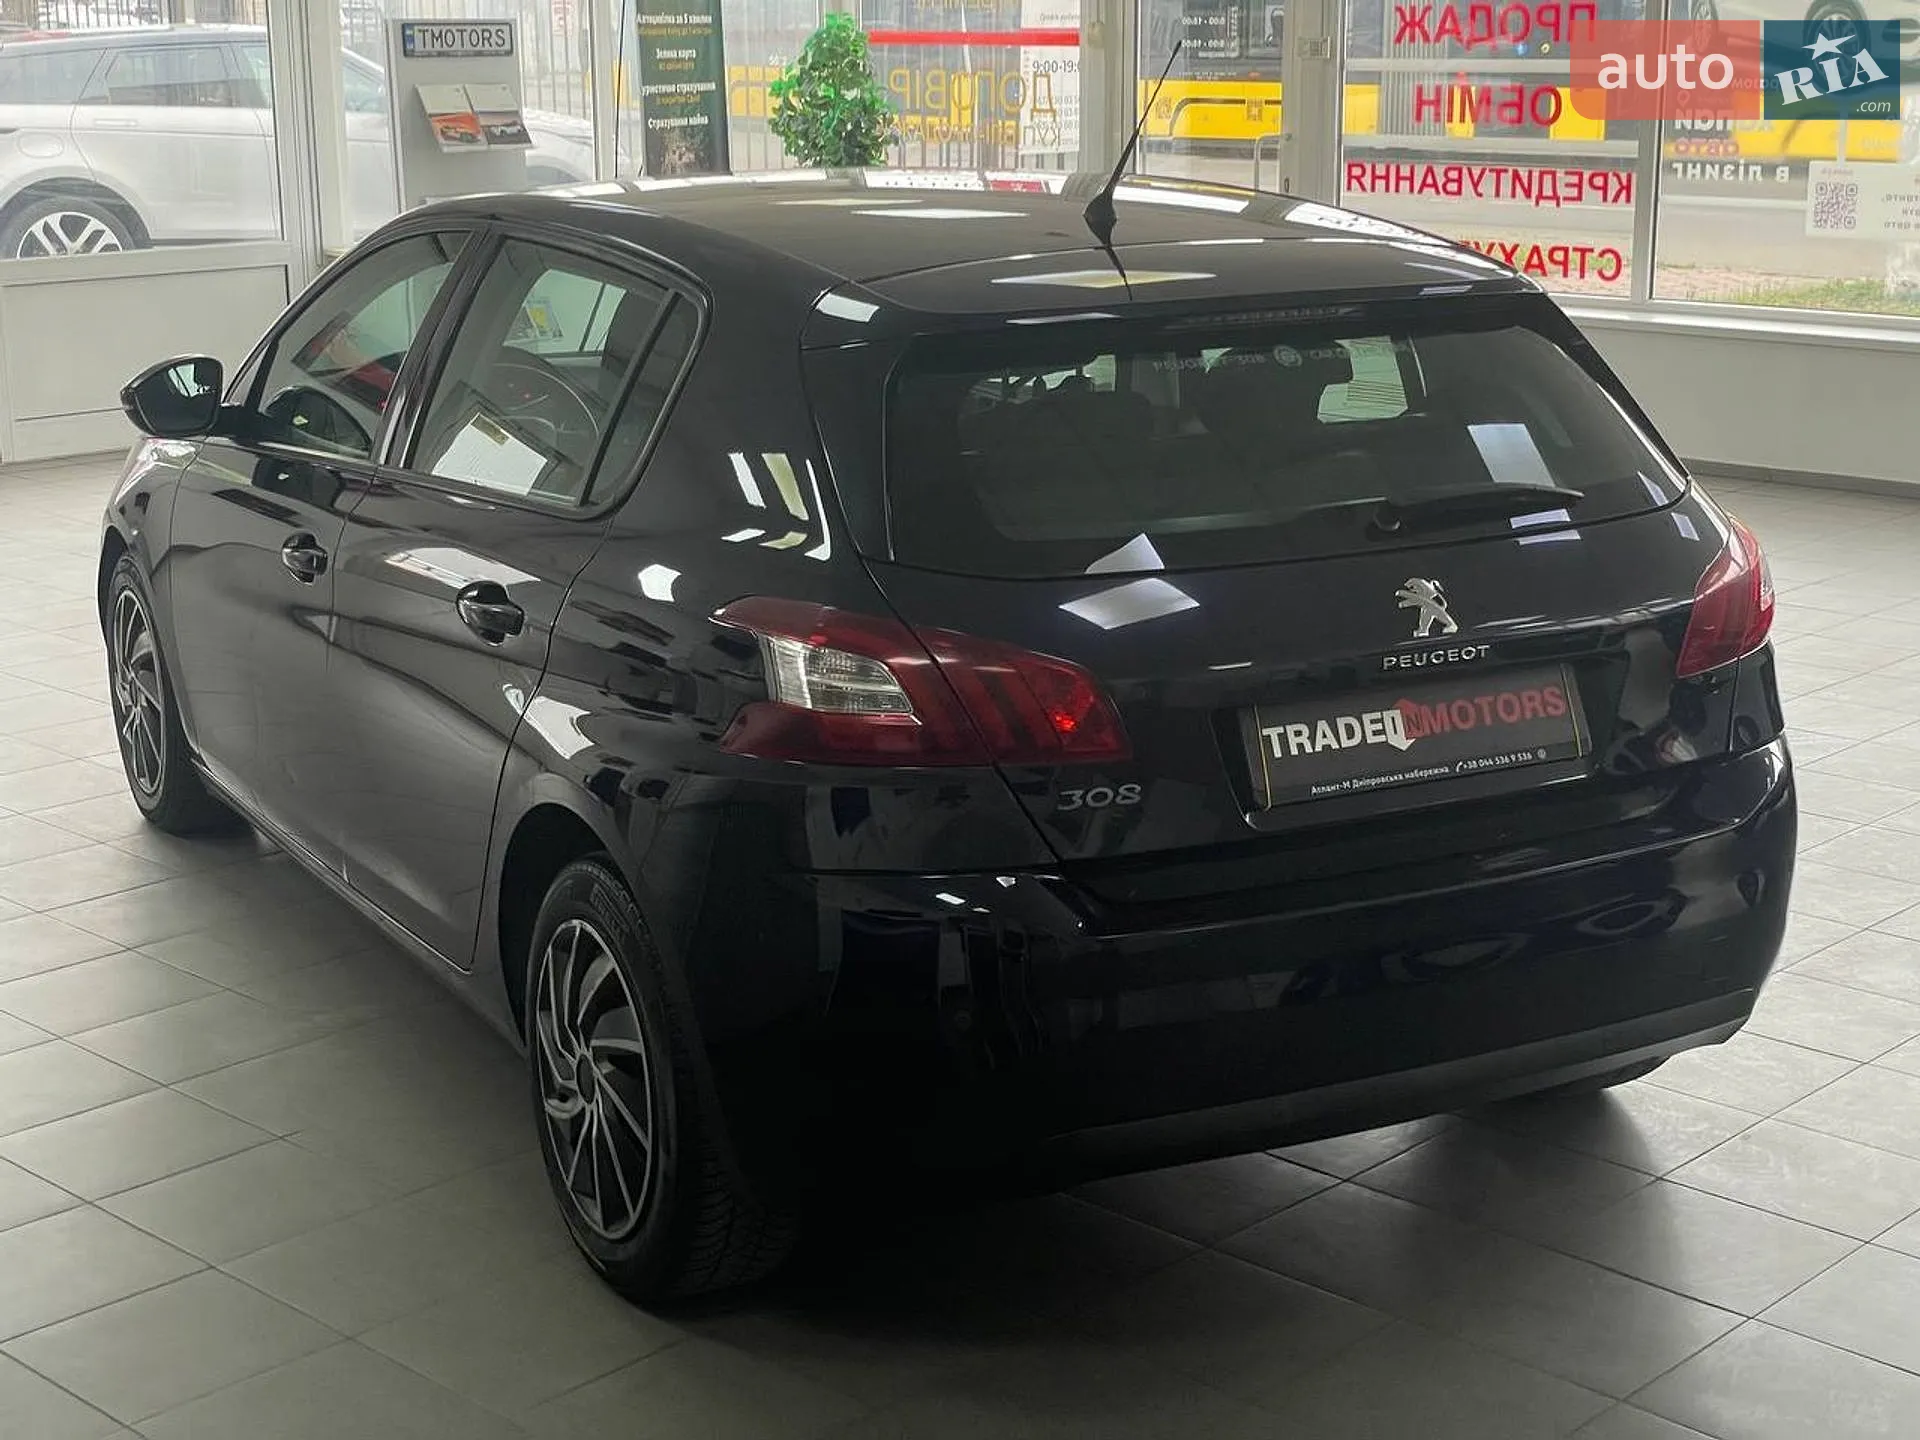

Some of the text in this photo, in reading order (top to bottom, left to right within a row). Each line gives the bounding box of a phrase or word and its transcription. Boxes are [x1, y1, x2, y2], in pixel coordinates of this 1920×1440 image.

[418, 28, 505, 48] TMOTORS
[1383, 645, 1490, 670] PEUGEOT
[1057, 784, 1142, 811] 308
